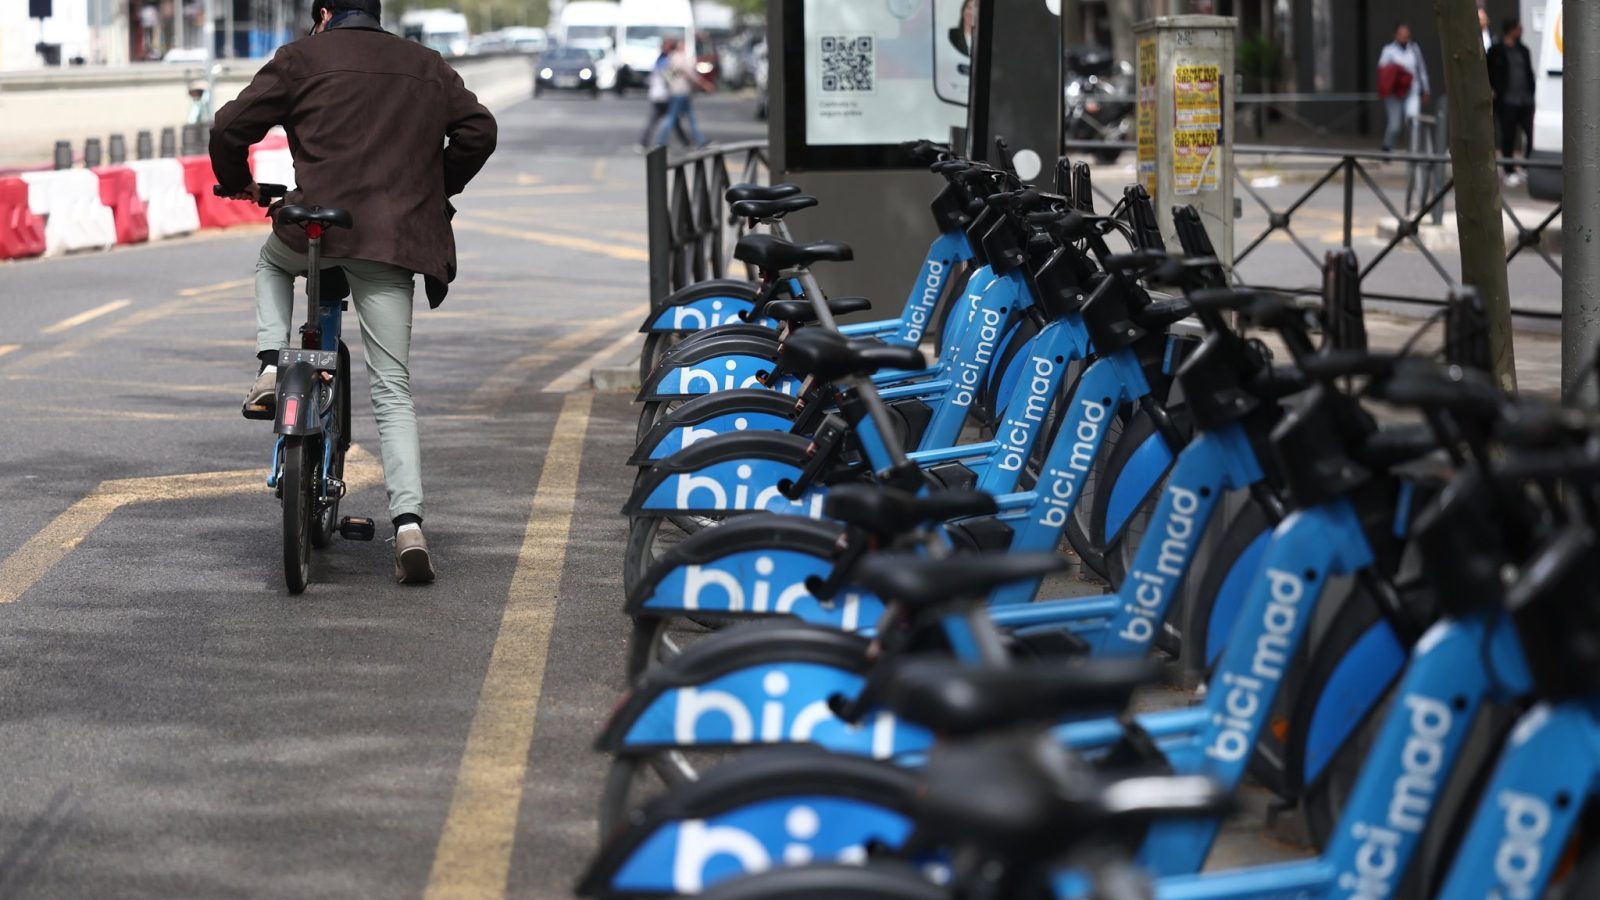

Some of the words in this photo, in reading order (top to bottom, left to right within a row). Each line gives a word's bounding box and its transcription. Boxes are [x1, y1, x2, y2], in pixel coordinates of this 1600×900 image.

[1176, 67, 1217, 76] COMPRO
[1175, 132, 1215, 140] COMPRO
[674, 301, 768, 330] bi
[1338, 694, 1453, 900] icimad
[1487, 789, 1552, 900] ad
